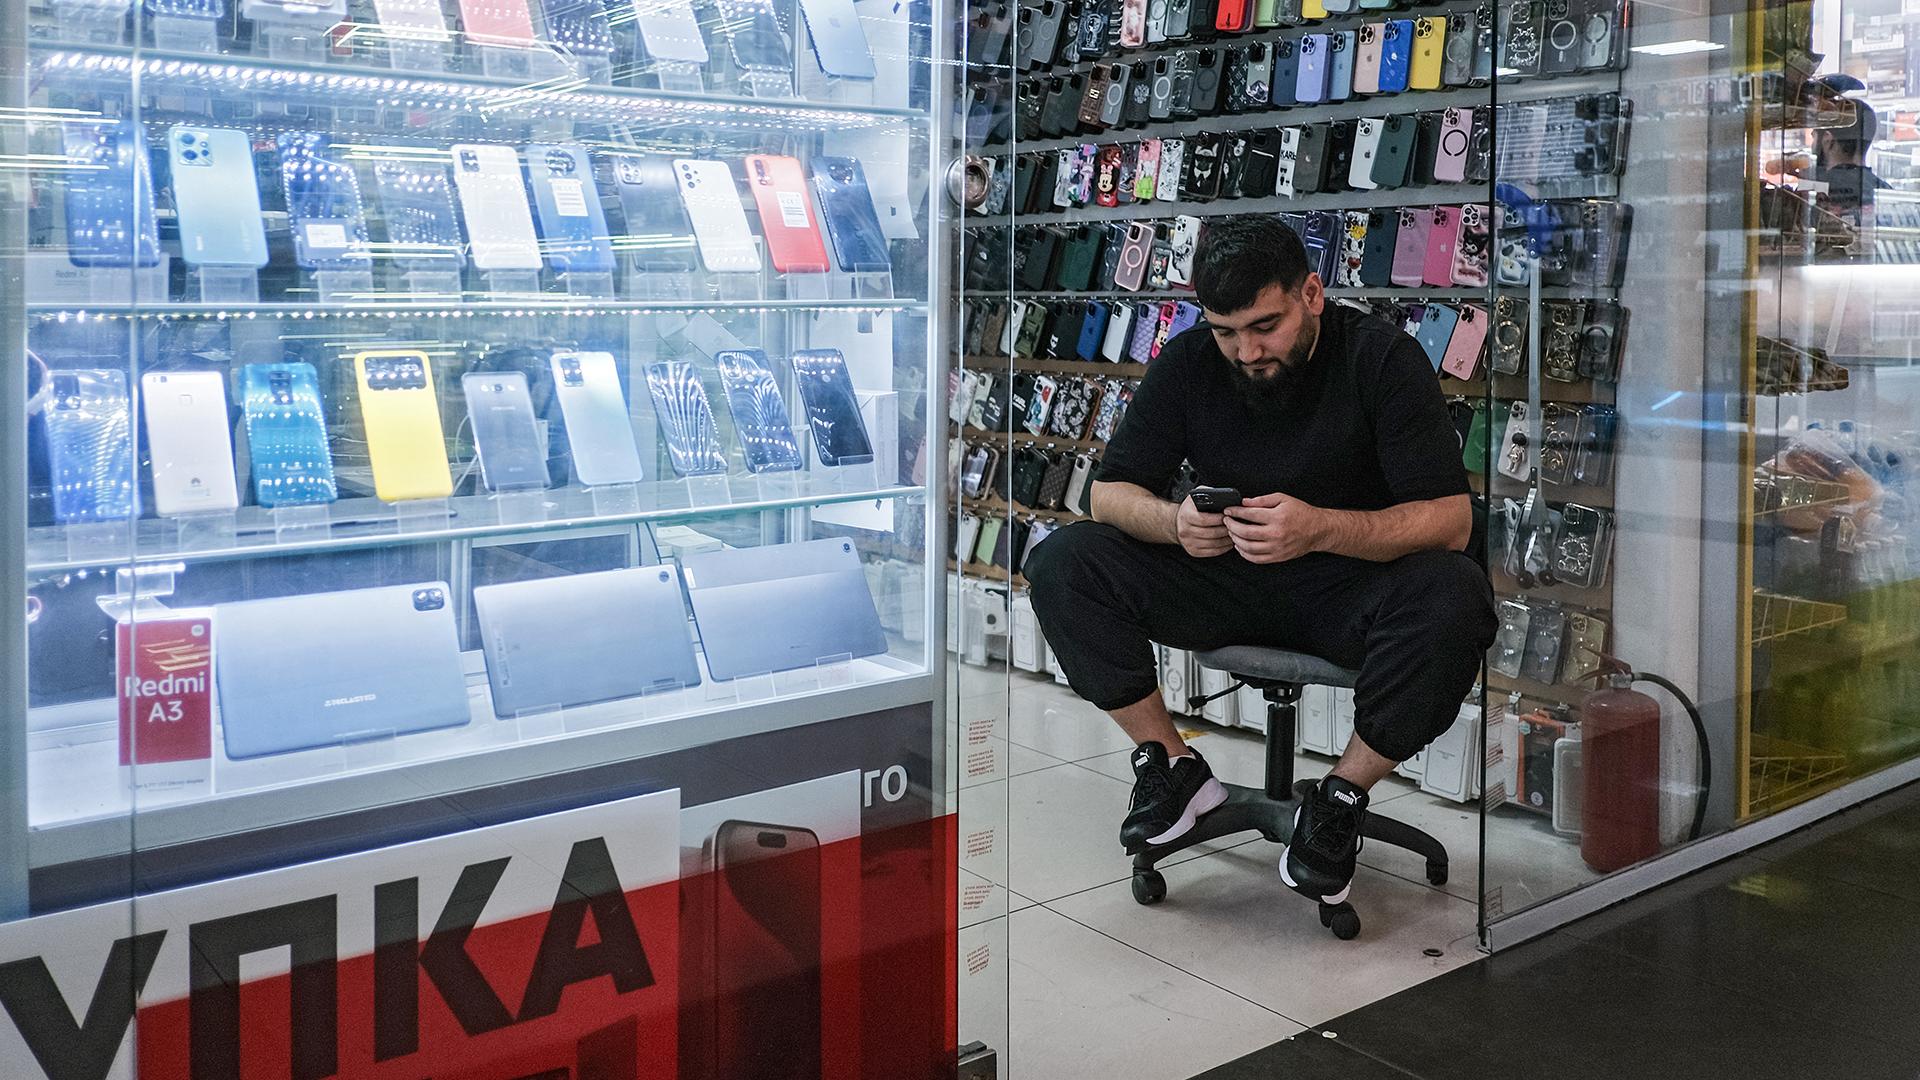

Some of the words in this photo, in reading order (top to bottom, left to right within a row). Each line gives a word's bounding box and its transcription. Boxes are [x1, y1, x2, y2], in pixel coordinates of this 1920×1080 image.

[124, 671, 205, 697] Redmi
[148, 700, 184, 722] A3
[1334, 790, 1355, 806] PUMA
[0, 836, 655, 1080] УПКА
